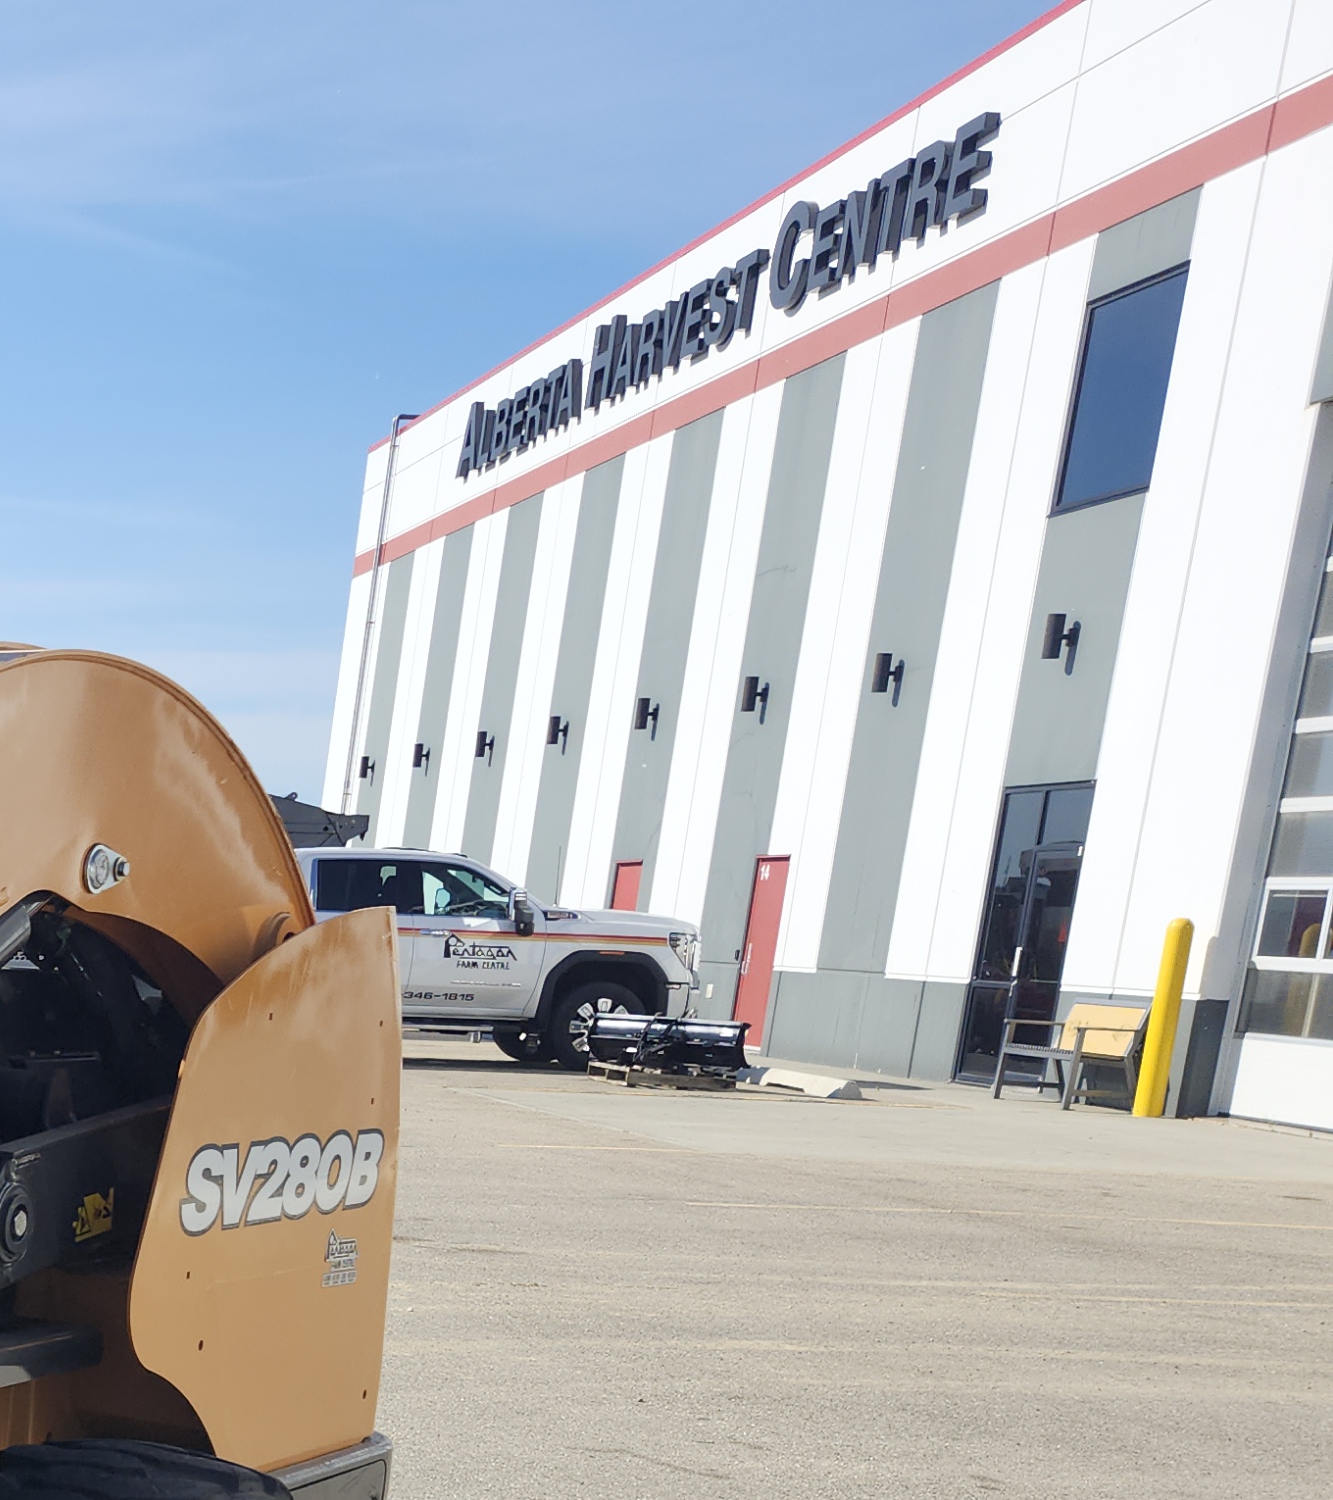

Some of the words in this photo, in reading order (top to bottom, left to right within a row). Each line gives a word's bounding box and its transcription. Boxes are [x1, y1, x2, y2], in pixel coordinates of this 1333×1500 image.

[457, 358, 583, 478] ALBERTA
[586, 249, 769, 410] HARVEST
[769, 111, 1001, 313] CENTRE
[760, 864, 771, 881] 14
[443, 934, 518, 961] Pentagon
[179, 1128, 385, 1236] SV280B
